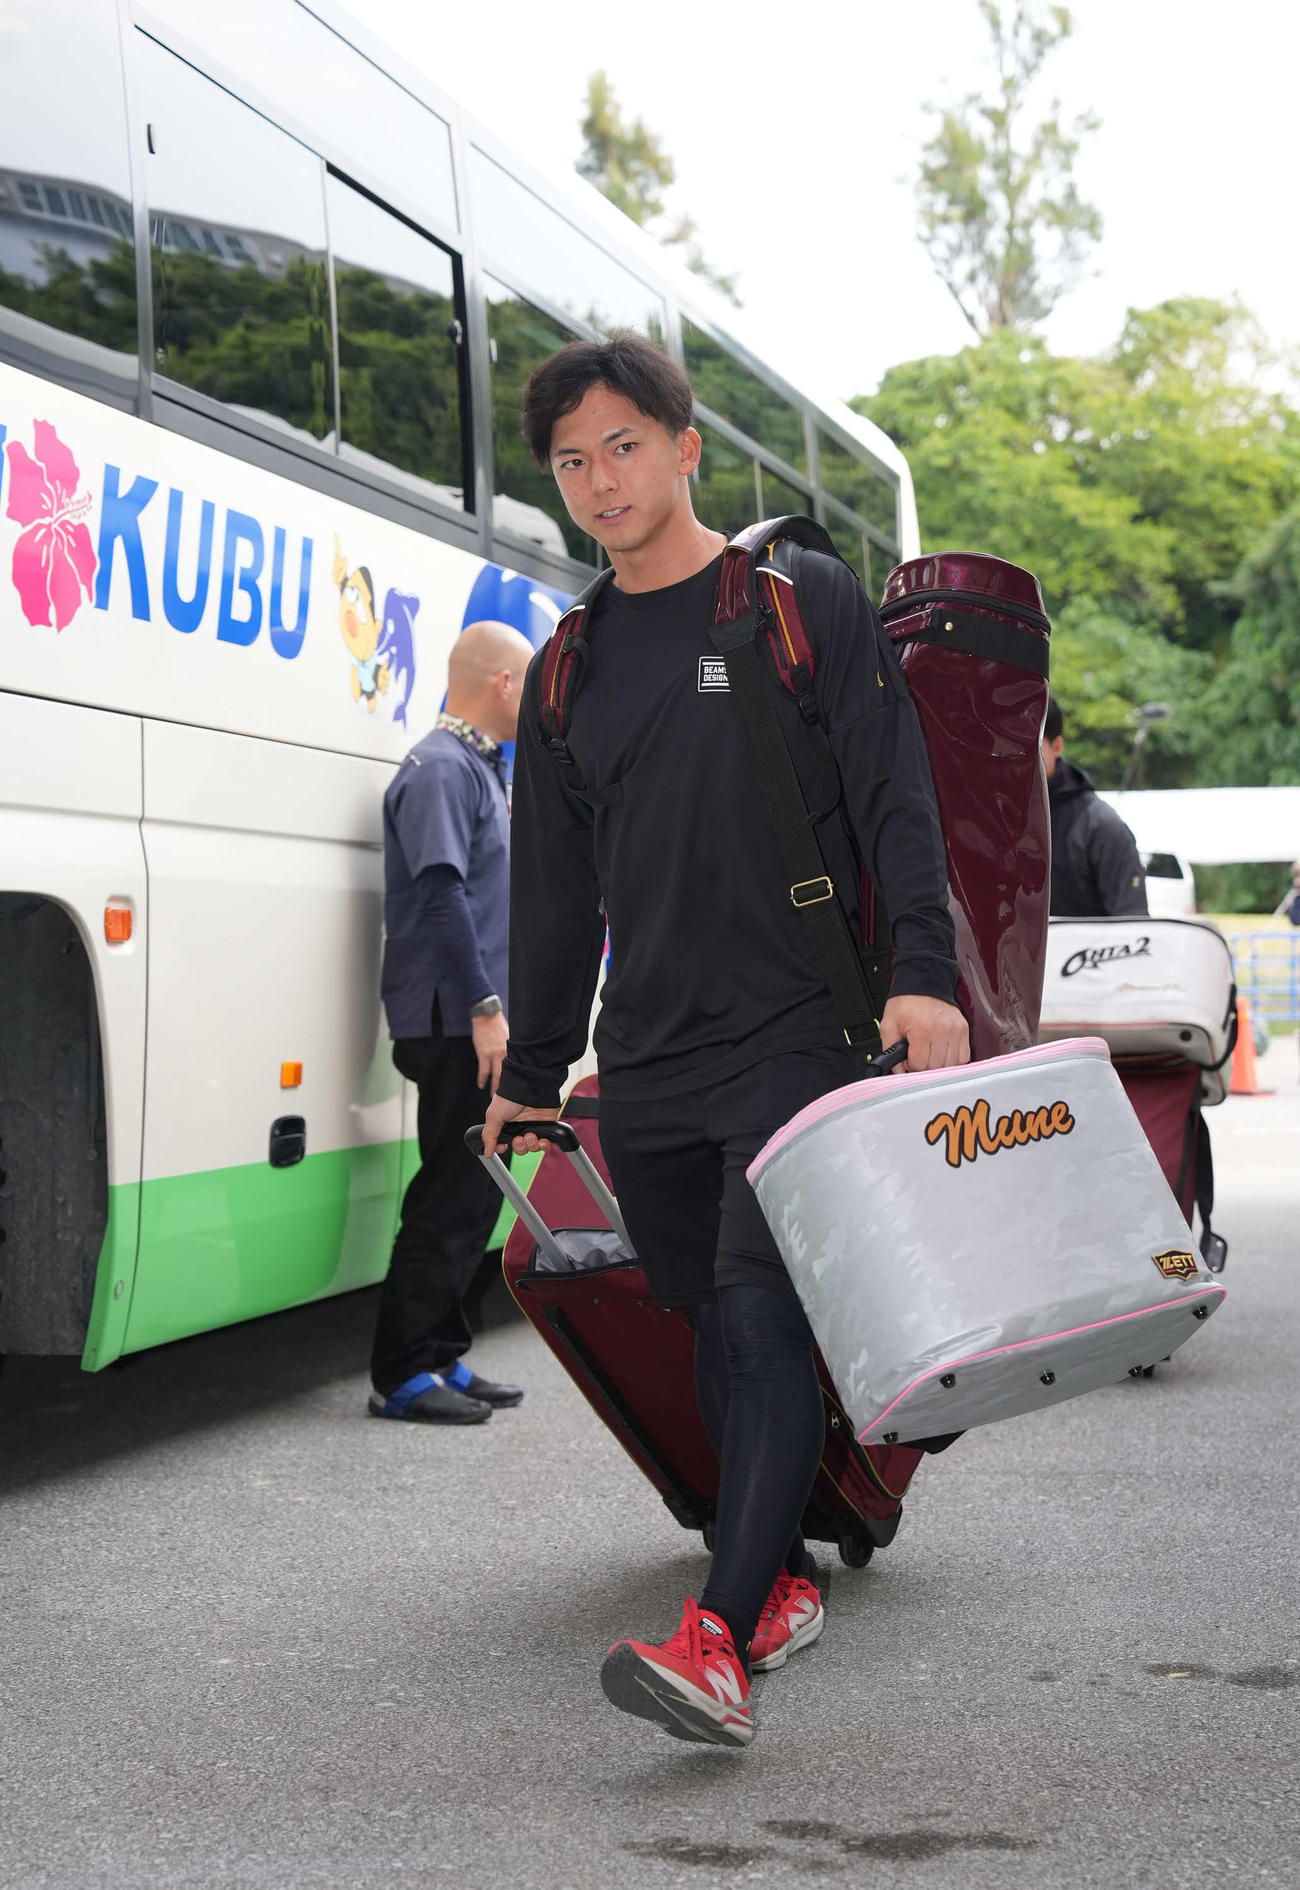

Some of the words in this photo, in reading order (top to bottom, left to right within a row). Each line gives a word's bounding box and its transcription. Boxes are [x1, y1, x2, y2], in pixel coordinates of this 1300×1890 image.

[95, 463, 313, 659] KUBU
[703, 674, 728, 682] DESIGN
[925, 1098, 1075, 1168] Mune
